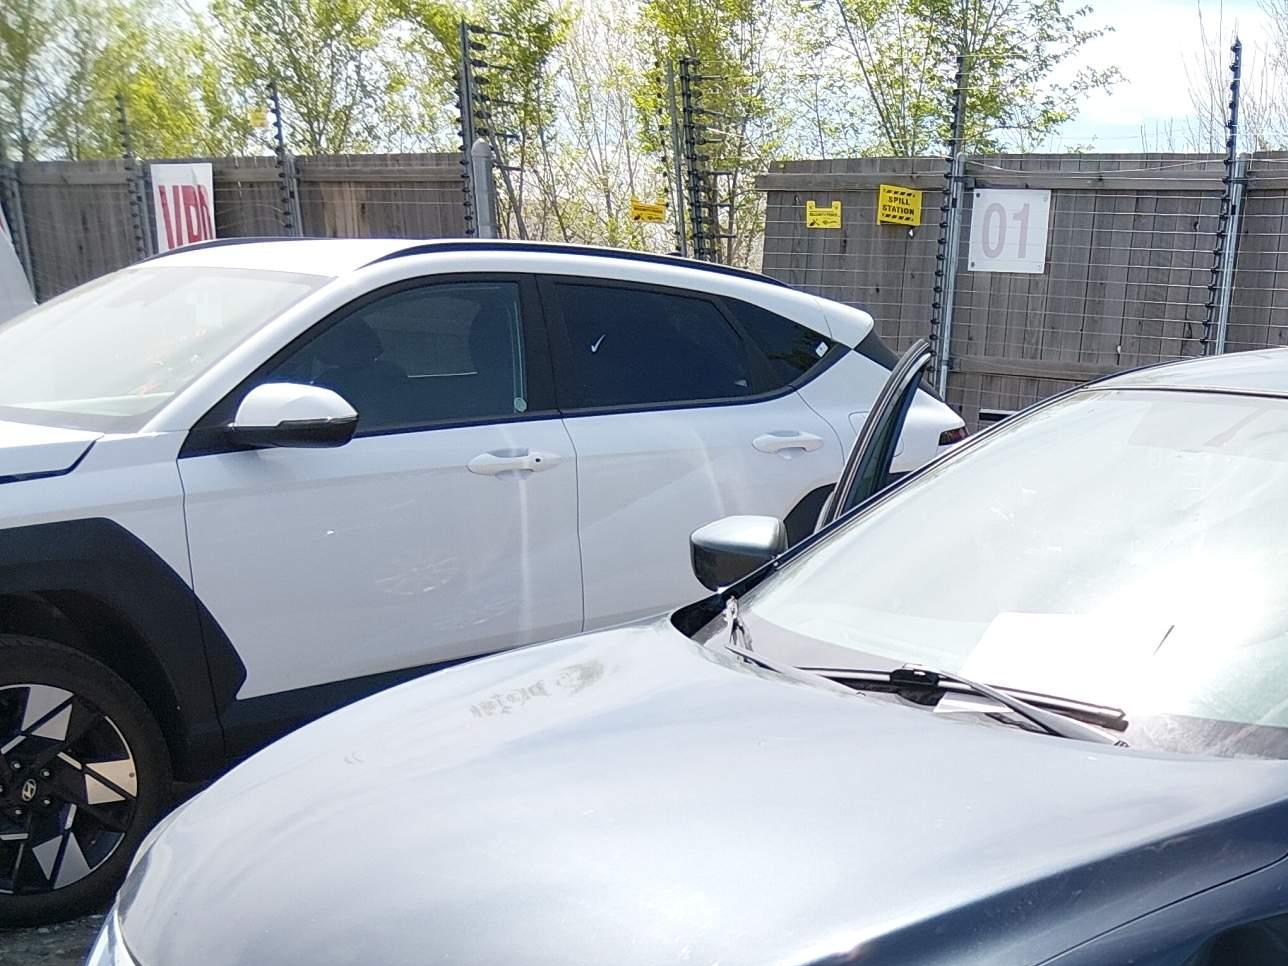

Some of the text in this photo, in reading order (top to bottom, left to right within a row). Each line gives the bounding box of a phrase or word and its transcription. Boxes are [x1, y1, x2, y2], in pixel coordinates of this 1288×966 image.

[889, 196, 910, 206] SPILL
[883, 204, 915, 217] STATION
[981, 202, 1033, 260] 01
